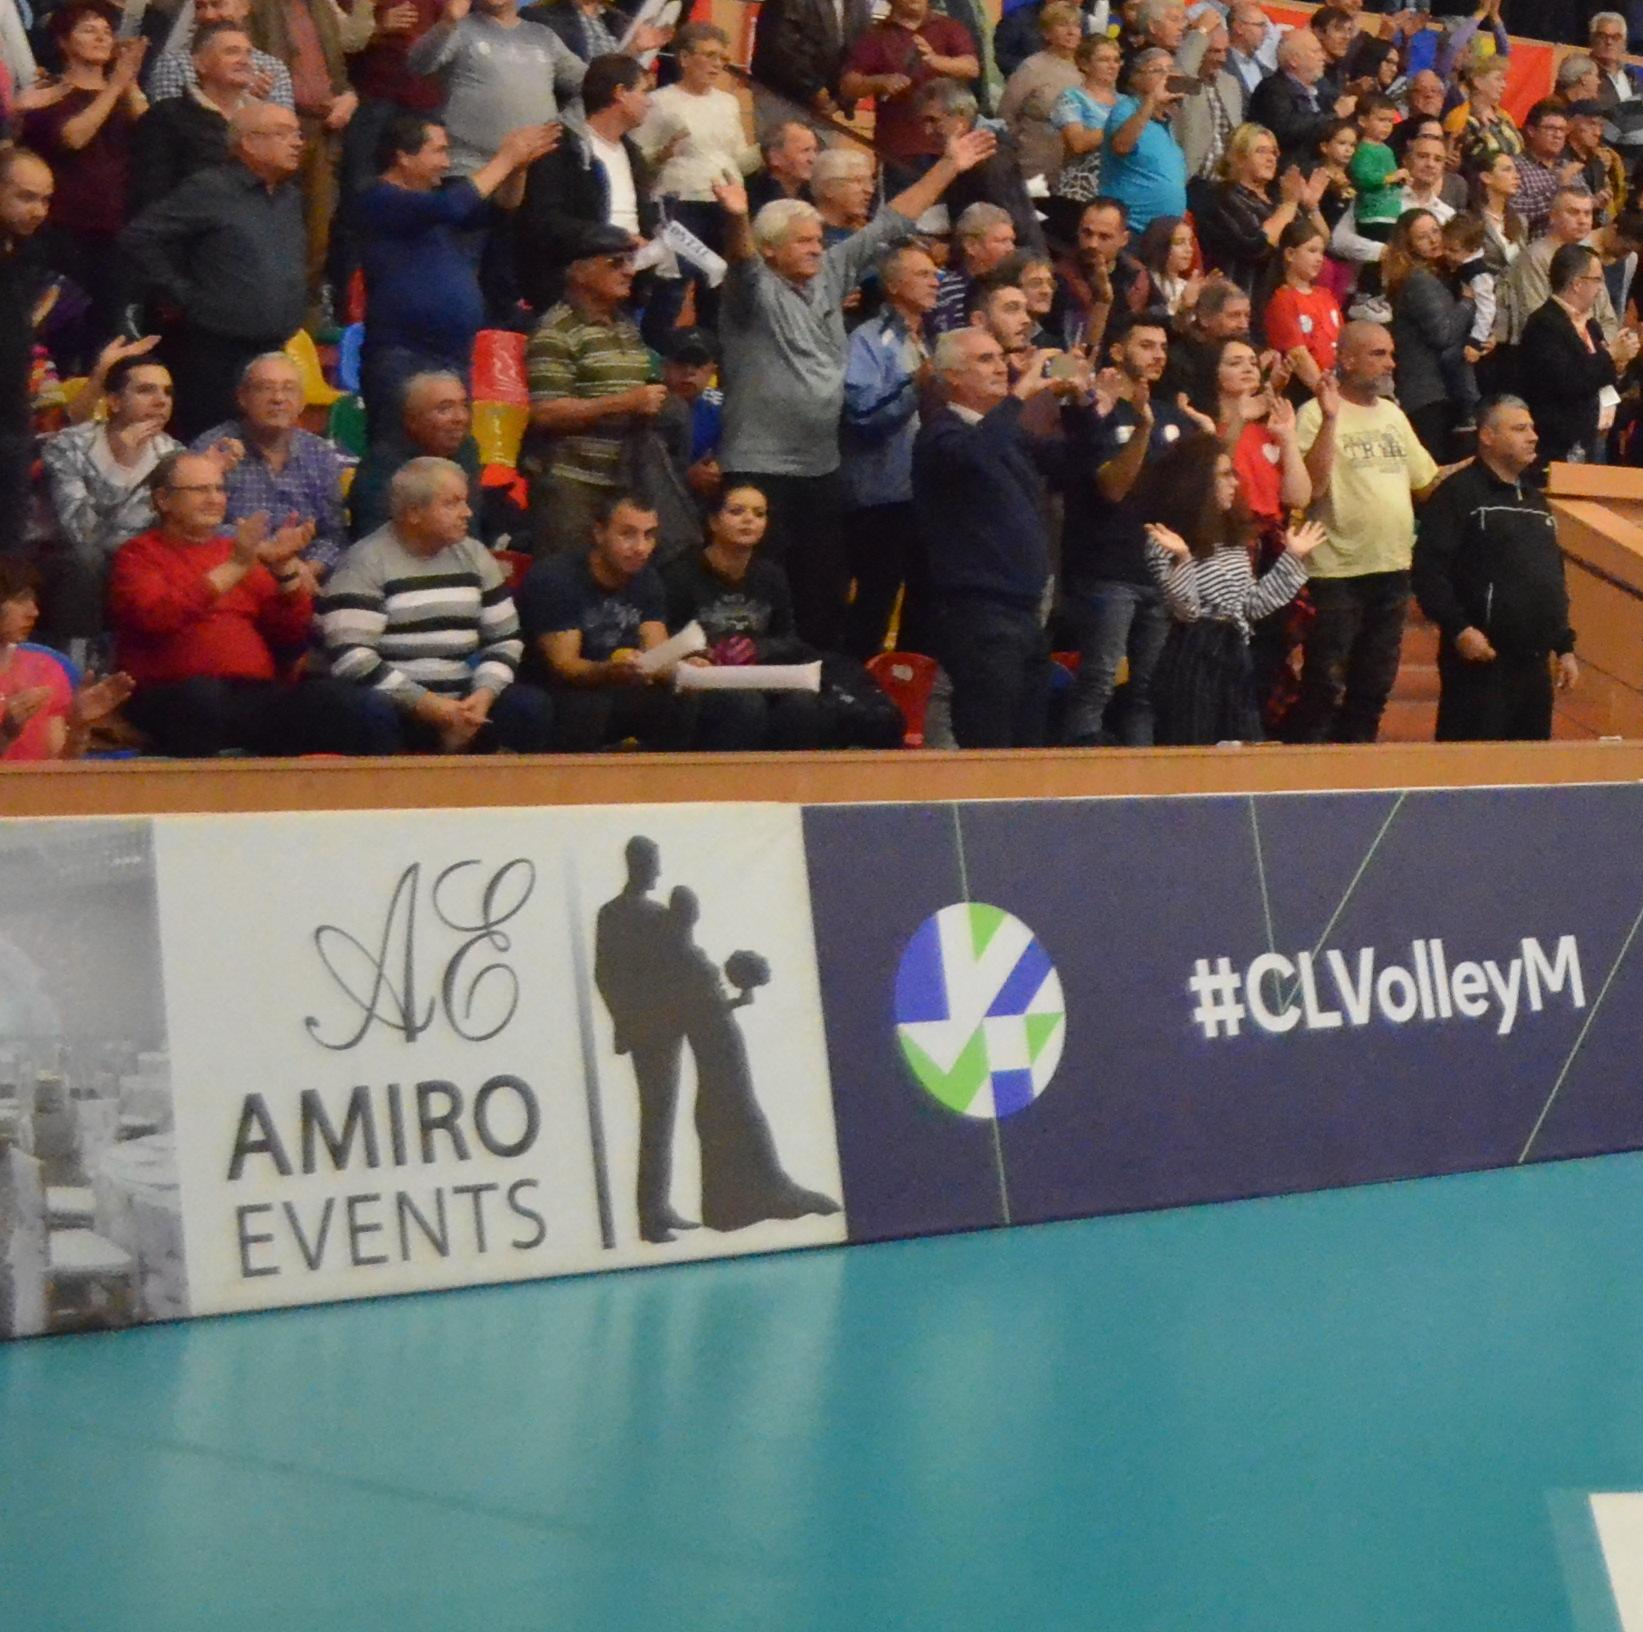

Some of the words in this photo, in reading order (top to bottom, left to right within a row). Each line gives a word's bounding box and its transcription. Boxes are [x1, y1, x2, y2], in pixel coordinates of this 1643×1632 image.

[1189, 934, 1586, 1038] #CLVolleyM
[227, 1074, 541, 1180] AMIRO
[235, 1178, 547, 1279] EVENTS
